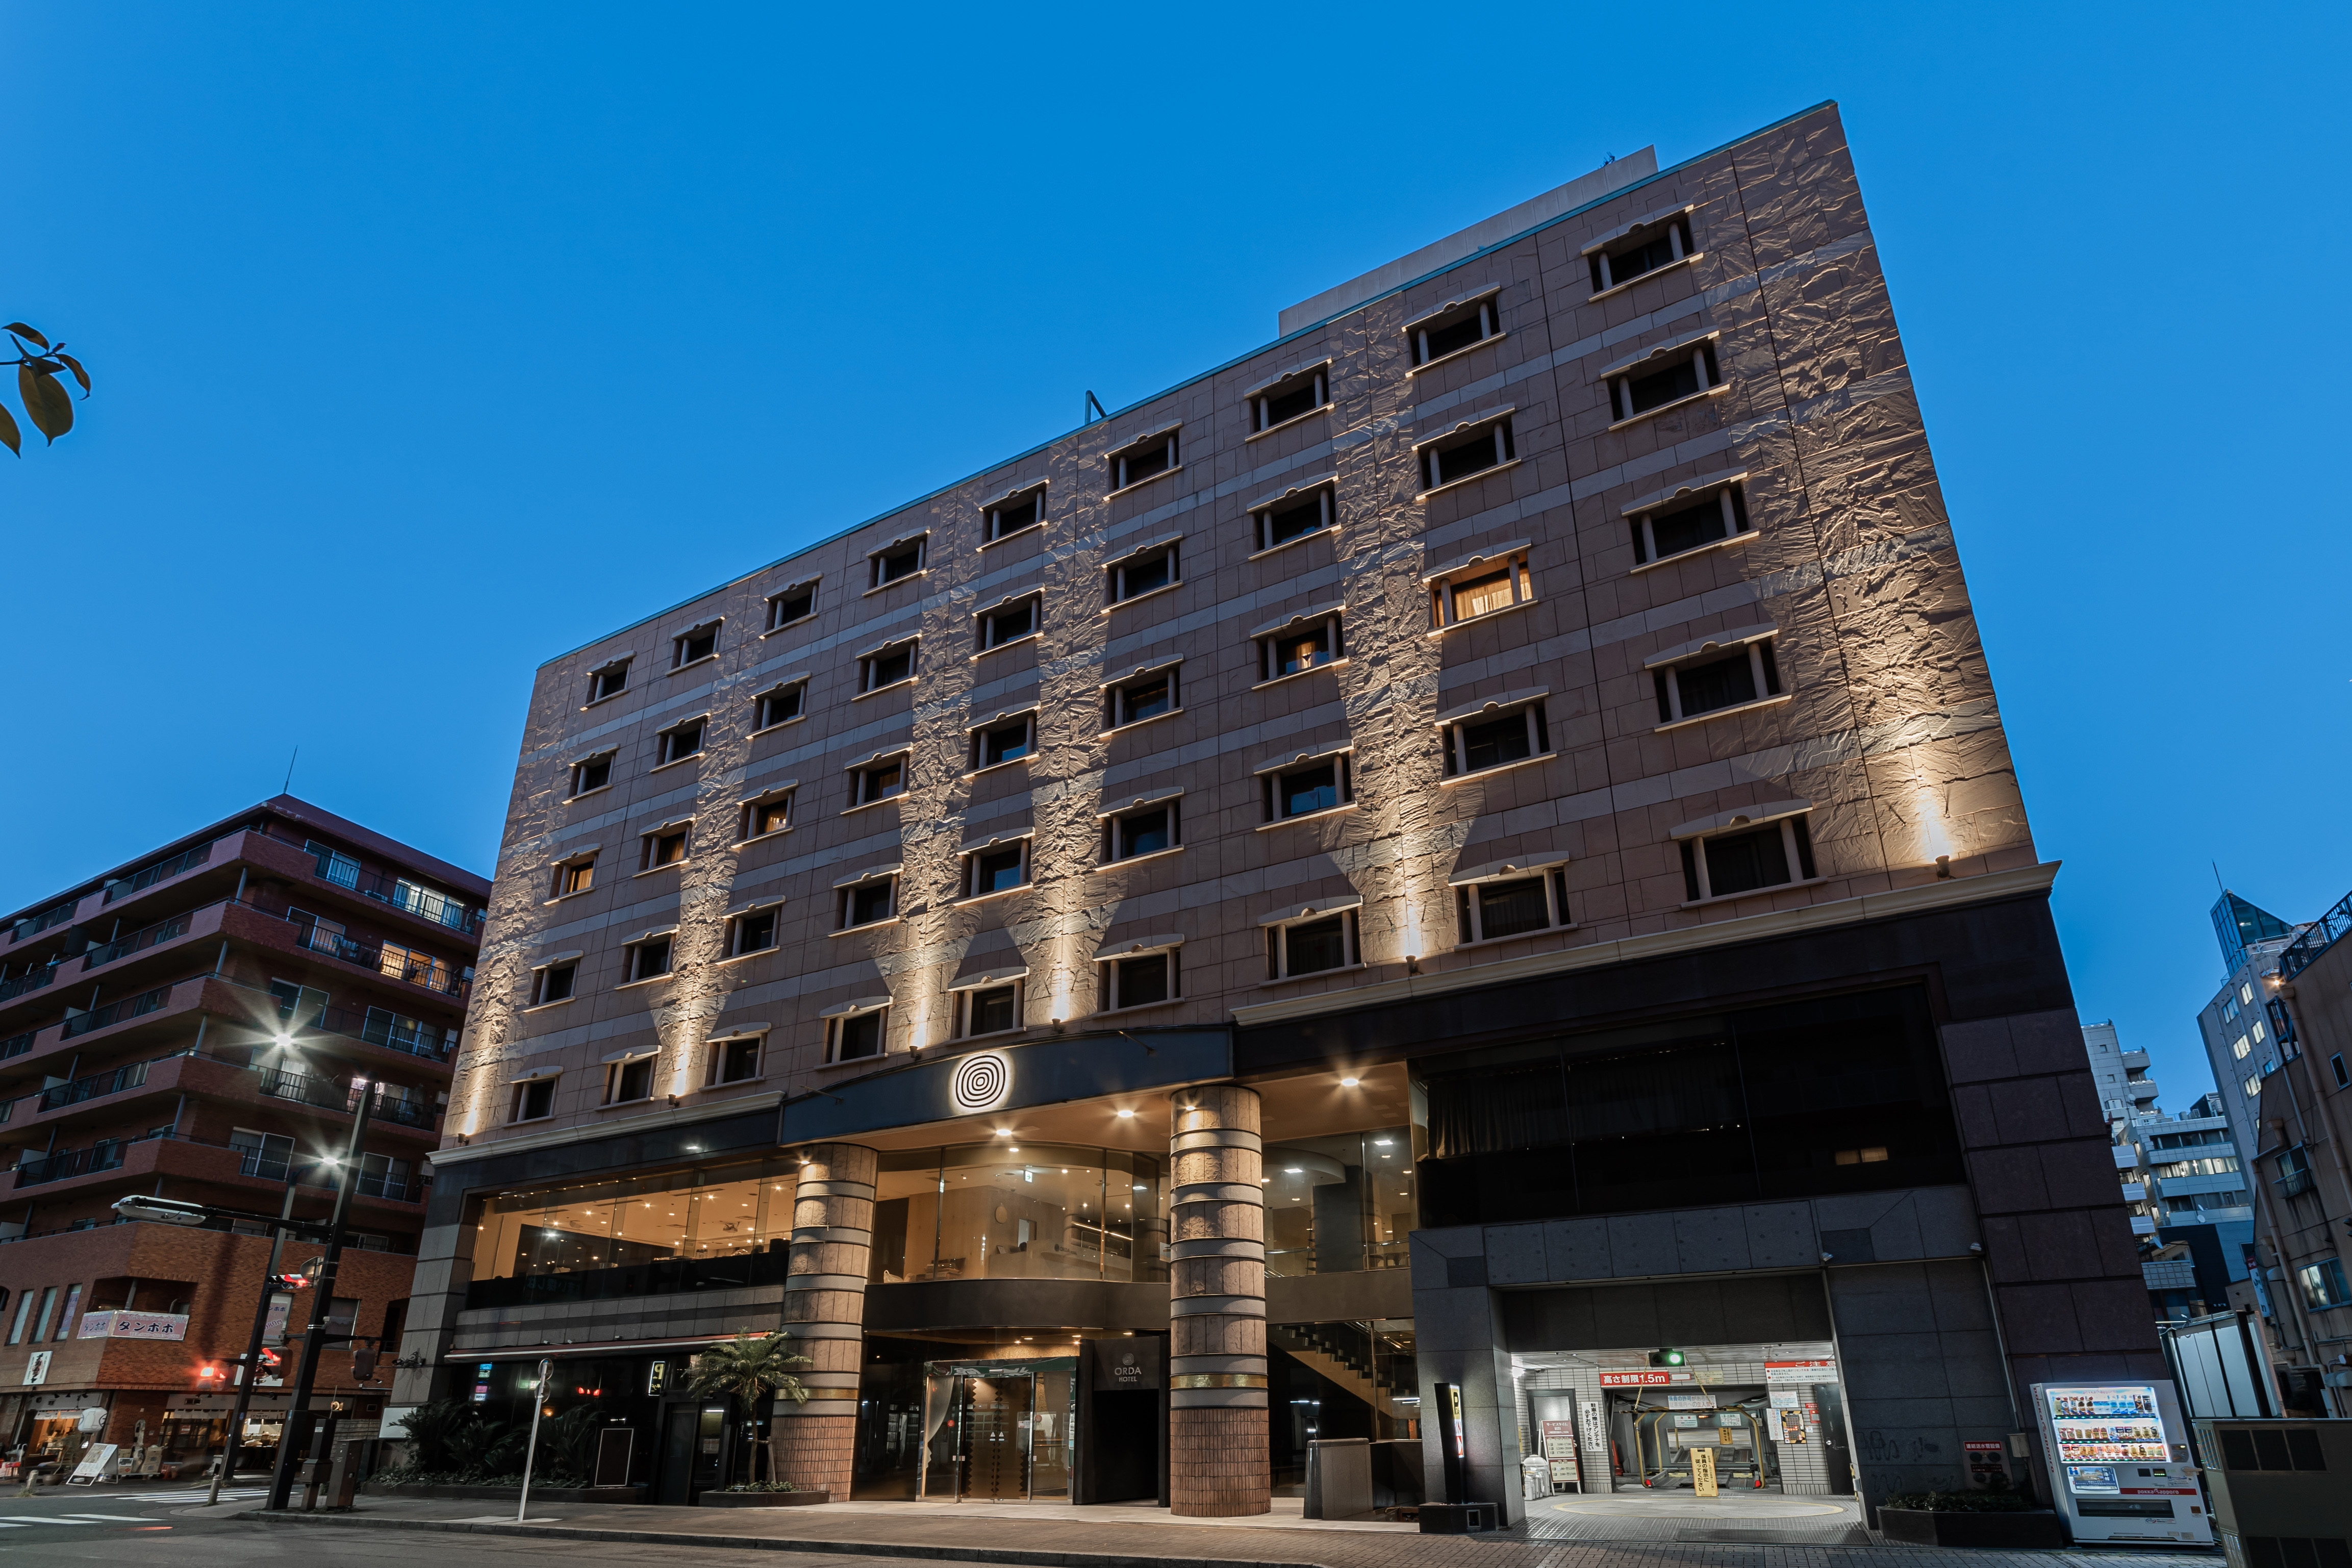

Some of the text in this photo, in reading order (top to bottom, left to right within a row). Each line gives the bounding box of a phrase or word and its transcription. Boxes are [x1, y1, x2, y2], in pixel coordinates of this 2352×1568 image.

[119, 1321, 176, 1333] タンポポ
[1115, 1367, 1142, 1375] ORDA
[1603, 1374, 1666, 1384] 高さ制限1.5m
[1453, 1392, 1459, 1414] P
[1585, 1409, 1594, 1450] 必ずお下げください
[1591, 1403, 1600, 1447] 駐車の際はアンテナを
[1696, 1459, 1704, 1491] 従ってください
[1701, 1454, 1709, 1482] 係員の指示に
